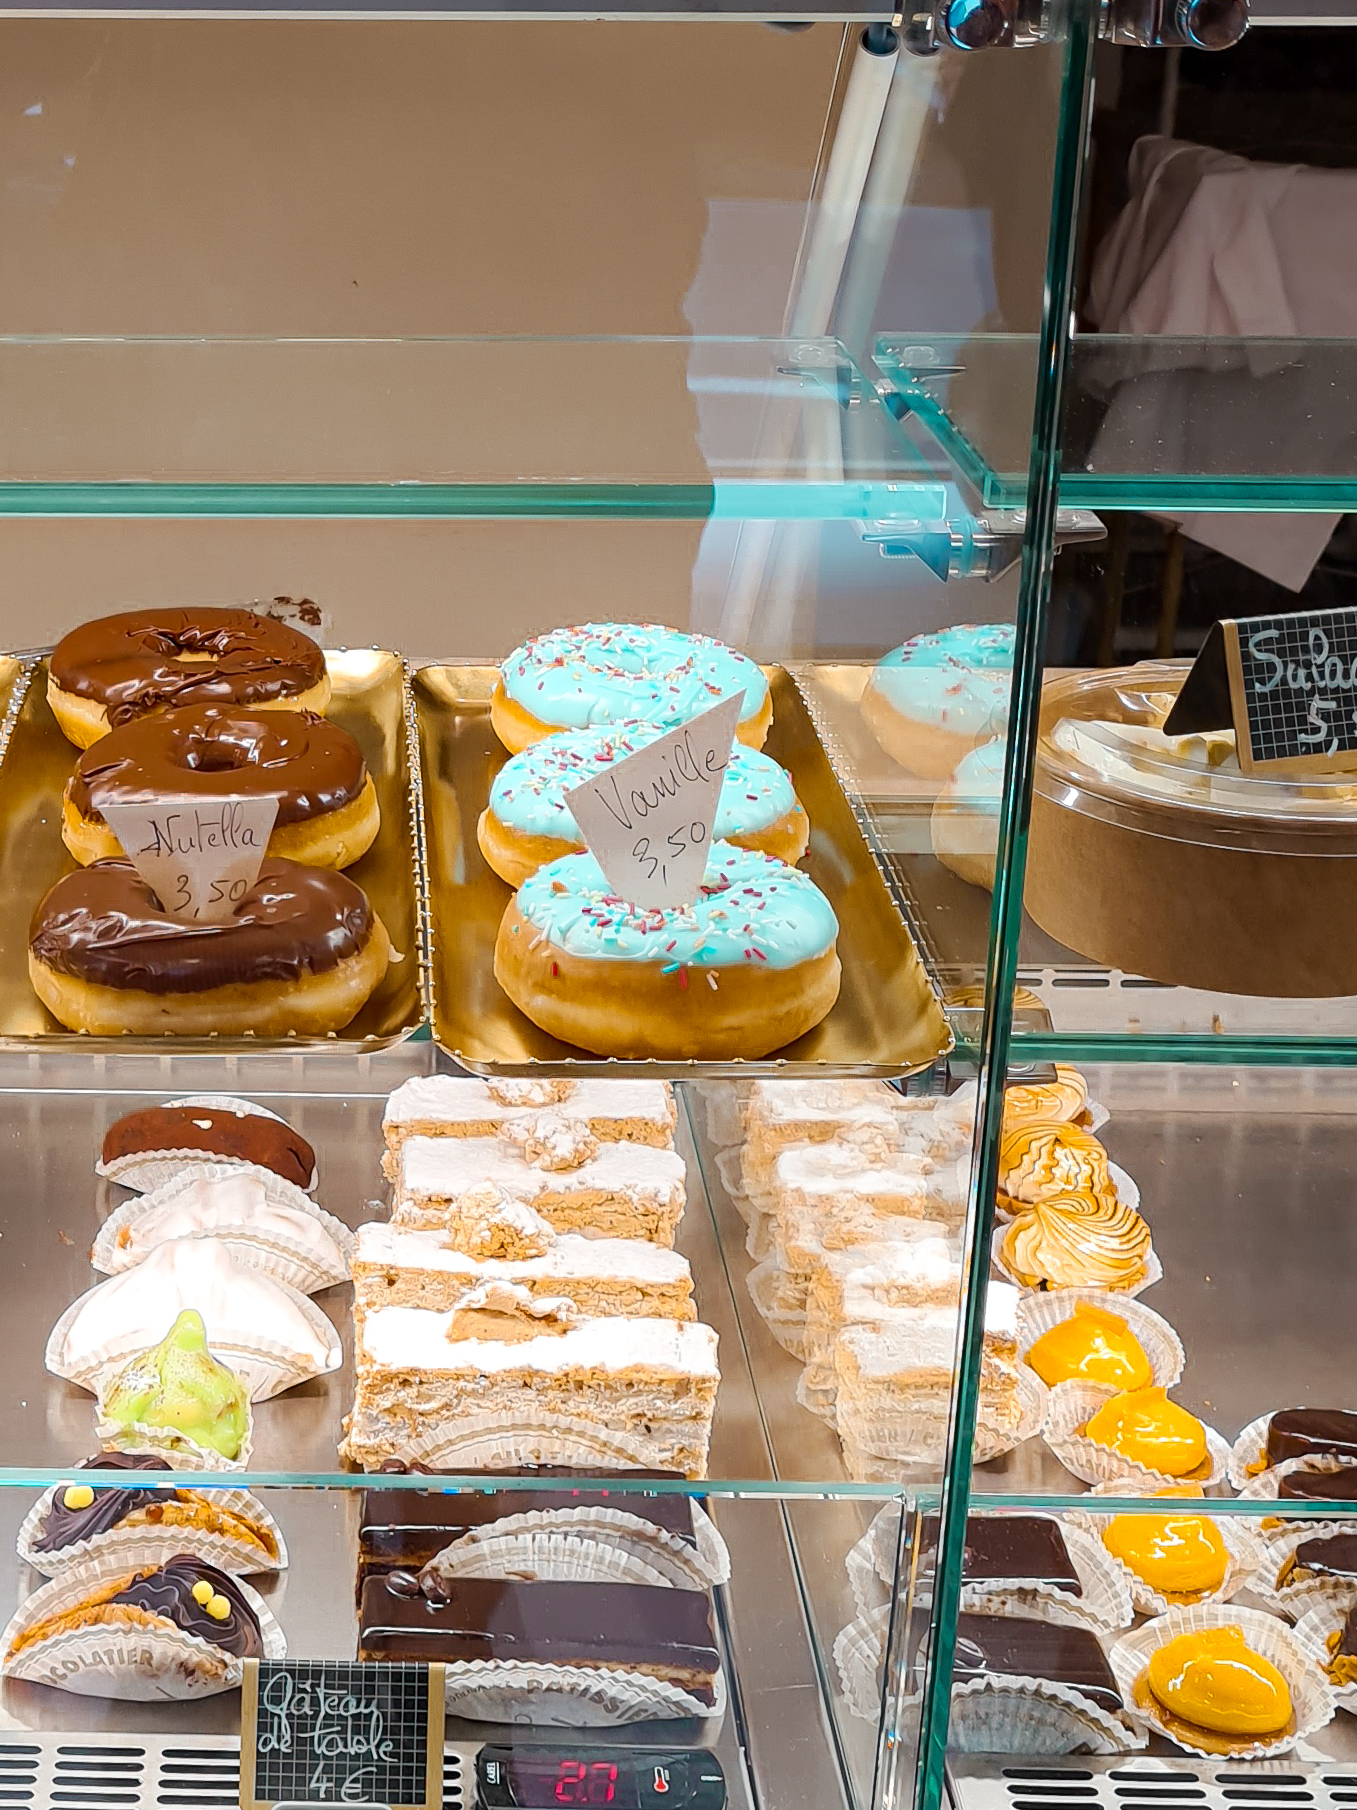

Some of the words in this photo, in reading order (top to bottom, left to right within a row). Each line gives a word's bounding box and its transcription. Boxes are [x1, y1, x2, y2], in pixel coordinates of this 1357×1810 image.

[594, 730, 729, 829] Vanille
[138, 802, 263, 858] Nutella
[632, 821, 706, 887] 3,50
[173, 874, 248, 918] 3,50
[258, 1716, 293, 1753] de
[298, 1711, 399, 1763] table
